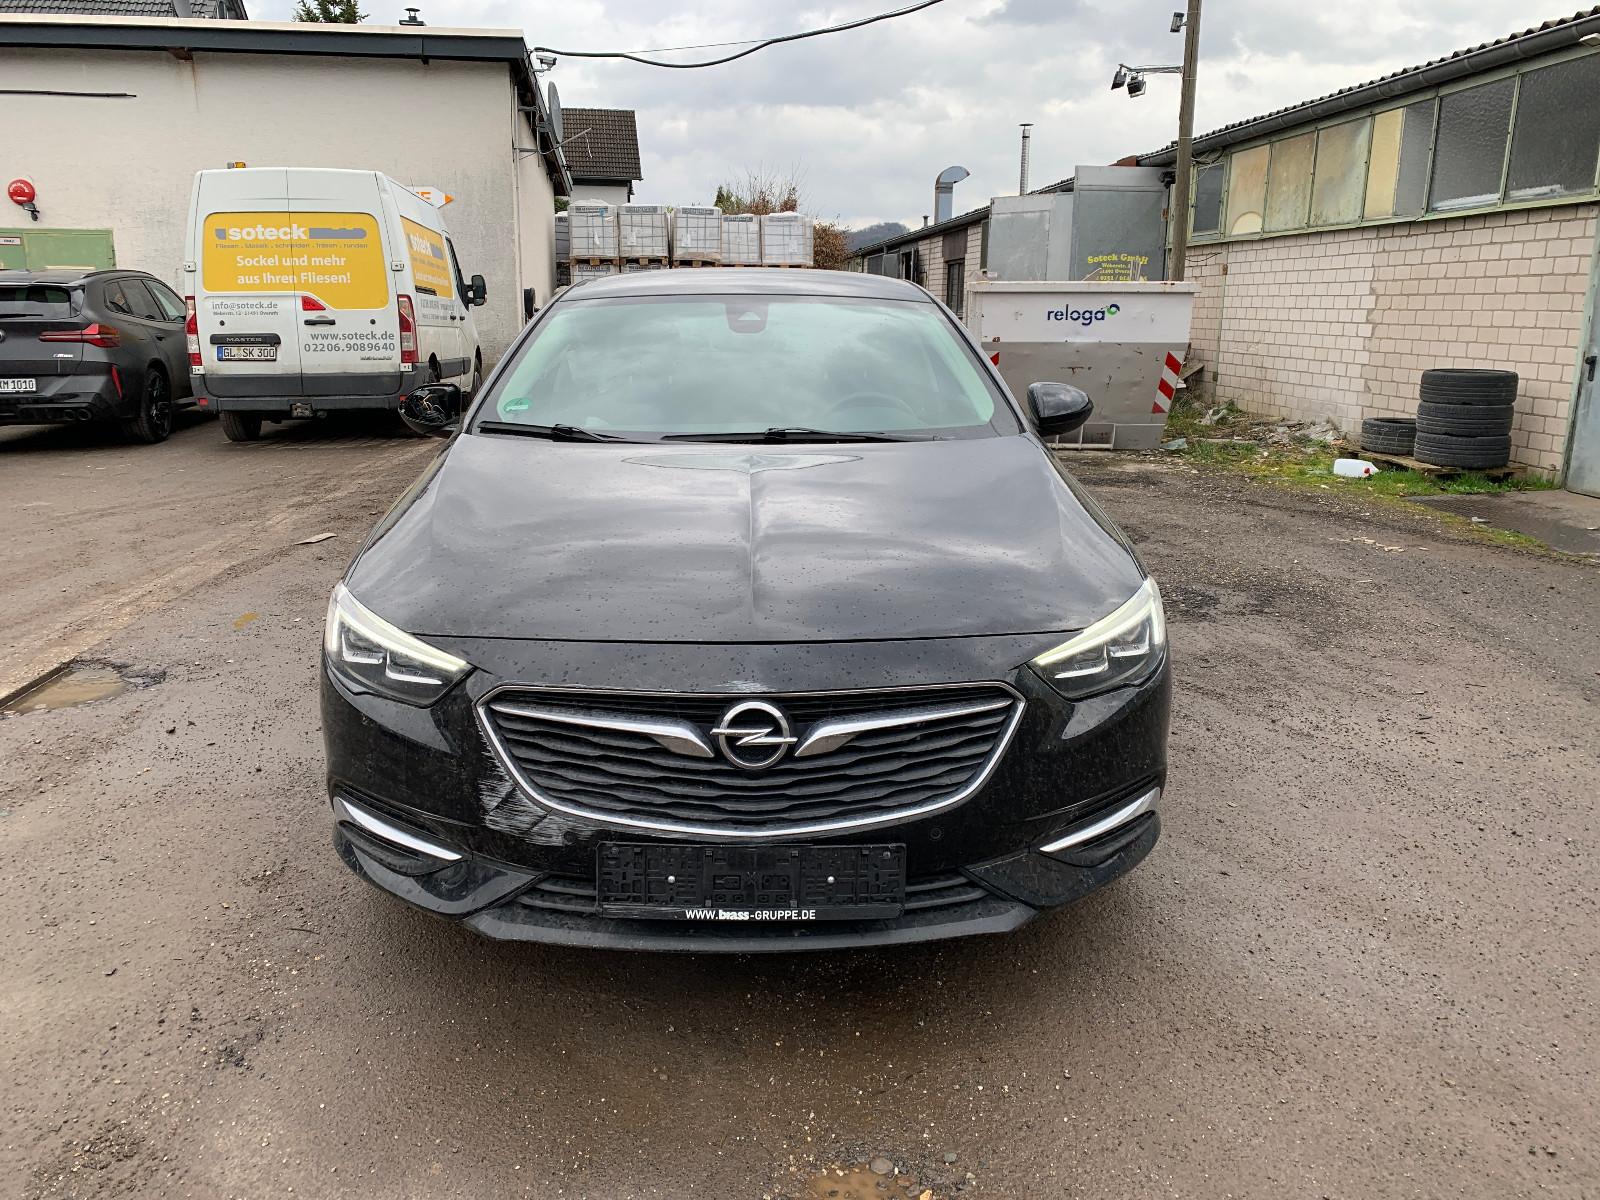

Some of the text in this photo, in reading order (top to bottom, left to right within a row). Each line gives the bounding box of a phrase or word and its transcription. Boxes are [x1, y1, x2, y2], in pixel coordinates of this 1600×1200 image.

[228, 224, 308, 240] soteck
[236, 255, 346, 267] Sockel und mehr
[237, 272, 351, 284] aus Ihren Fliesen!
[212, 301, 279, 310] info@soteck.de
[1047, 304, 1106, 326] reloga
[310, 331, 395, 341] www.soteck.de
[223, 348, 275, 358] GL SK 300
[304, 343, 395, 353] 02206.9089640
[11, 380, 34, 390] 1010
[685, 909, 816, 920] WWW.brass-GRUPPE.DE
